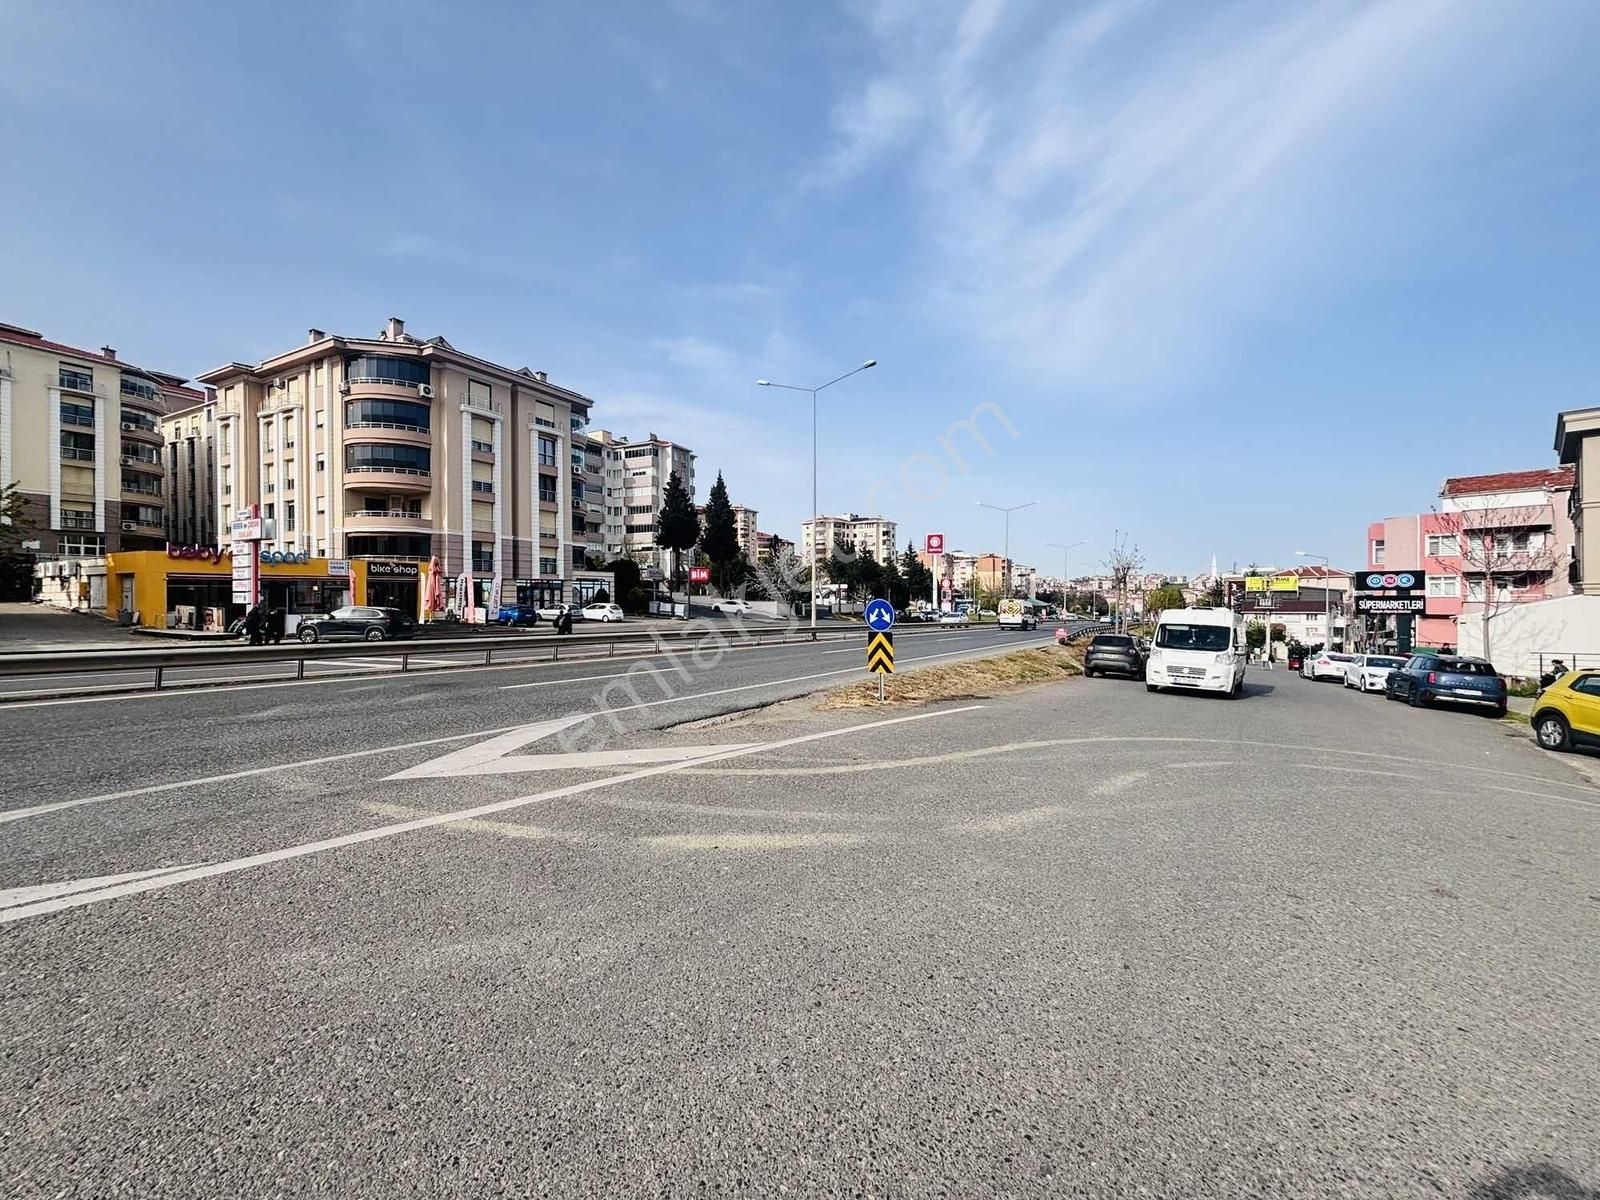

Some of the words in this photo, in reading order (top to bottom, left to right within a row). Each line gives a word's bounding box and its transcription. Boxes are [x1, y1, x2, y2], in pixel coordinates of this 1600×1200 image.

[166, 541, 223, 566] baby
[260, 549, 309, 567] sport
[370, 564, 391, 573] bike
[393, 565, 417, 575] shop
[1358, 598, 1424, 610] SÜPERMARKETLERİ
